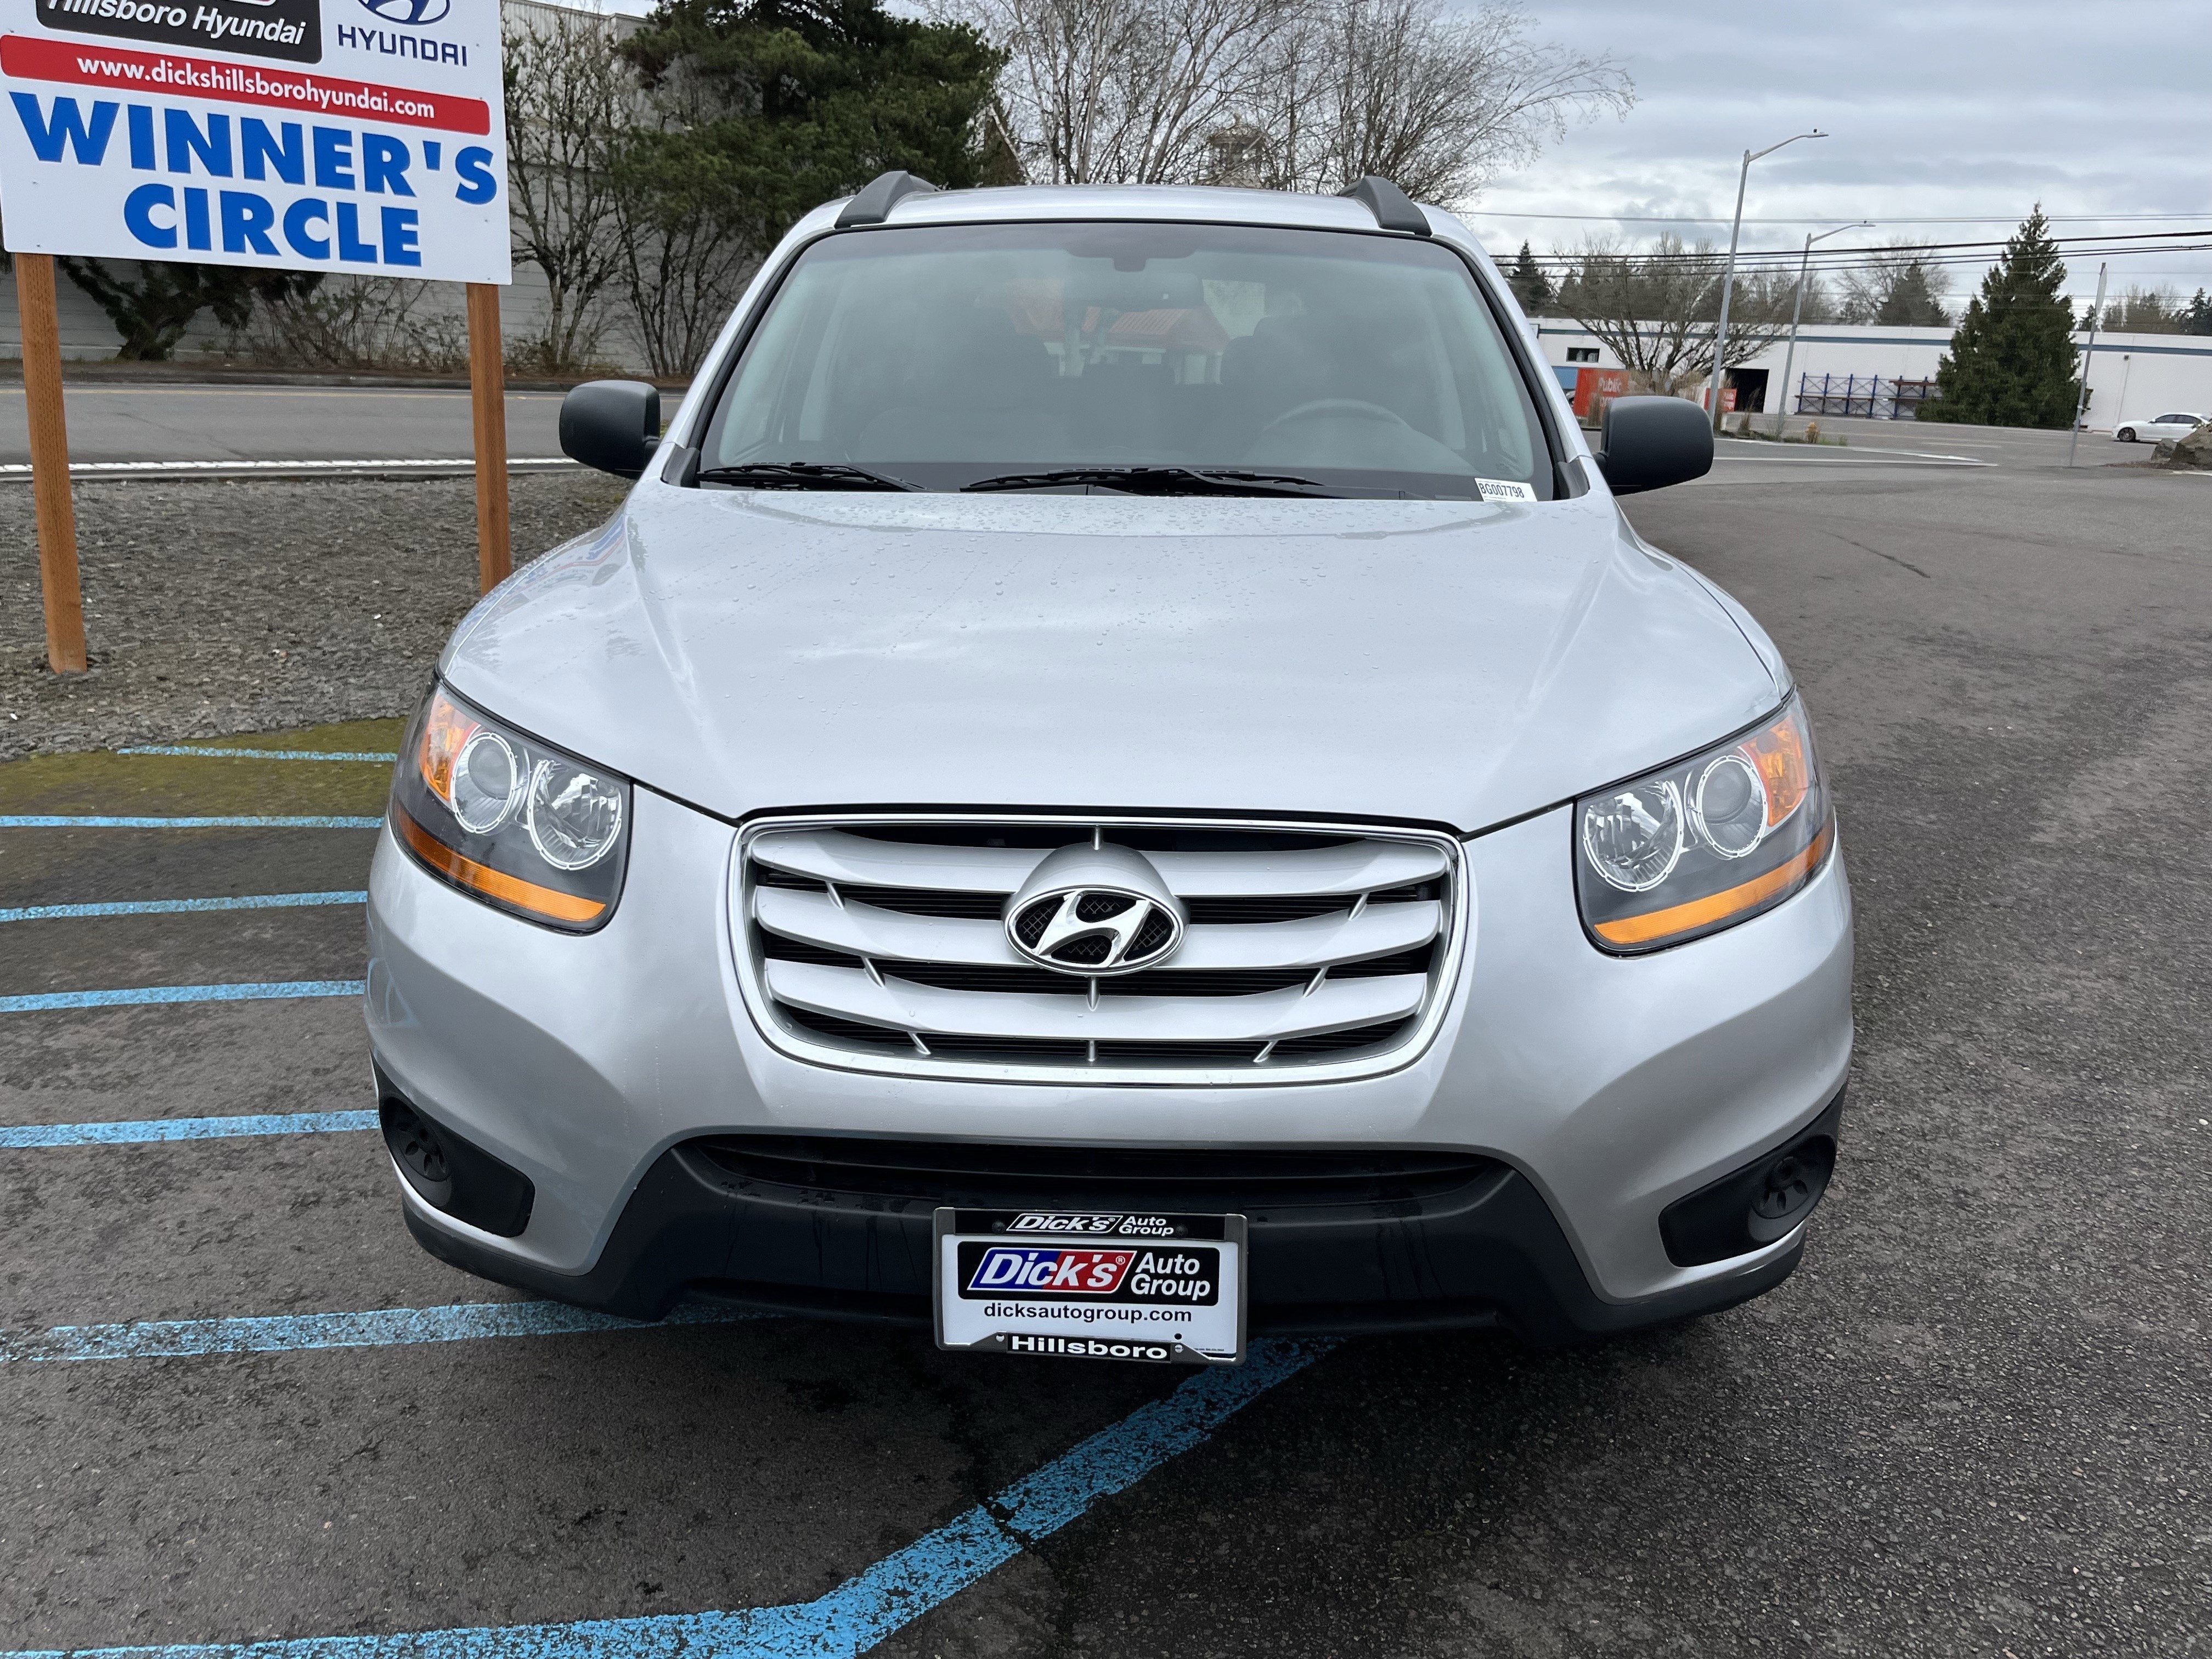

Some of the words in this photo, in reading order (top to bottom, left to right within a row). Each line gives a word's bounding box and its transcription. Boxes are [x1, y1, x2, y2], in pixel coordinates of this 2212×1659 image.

[192, 5, 307, 46] Hyundai
[337, 24, 467, 67] HYUNDAI
[76, 55, 435, 119] www.dickshillsborohyundai.com
[8, 91, 498, 205] WINNER'S
[123, 183, 422, 268] CIRCLE
[1478, 483, 1525, 498] BG007798
[1118, 1224, 1175, 1237] Group
[1122, 1215, 1167, 1226] Auto
[1135, 1251, 1200, 1275] Auto
[1130, 1273, 1211, 1301] Group
[984, 1302, 1192, 1324] dicksautogroup.com
[1012, 1335, 1169, 1360] Hillsboro
